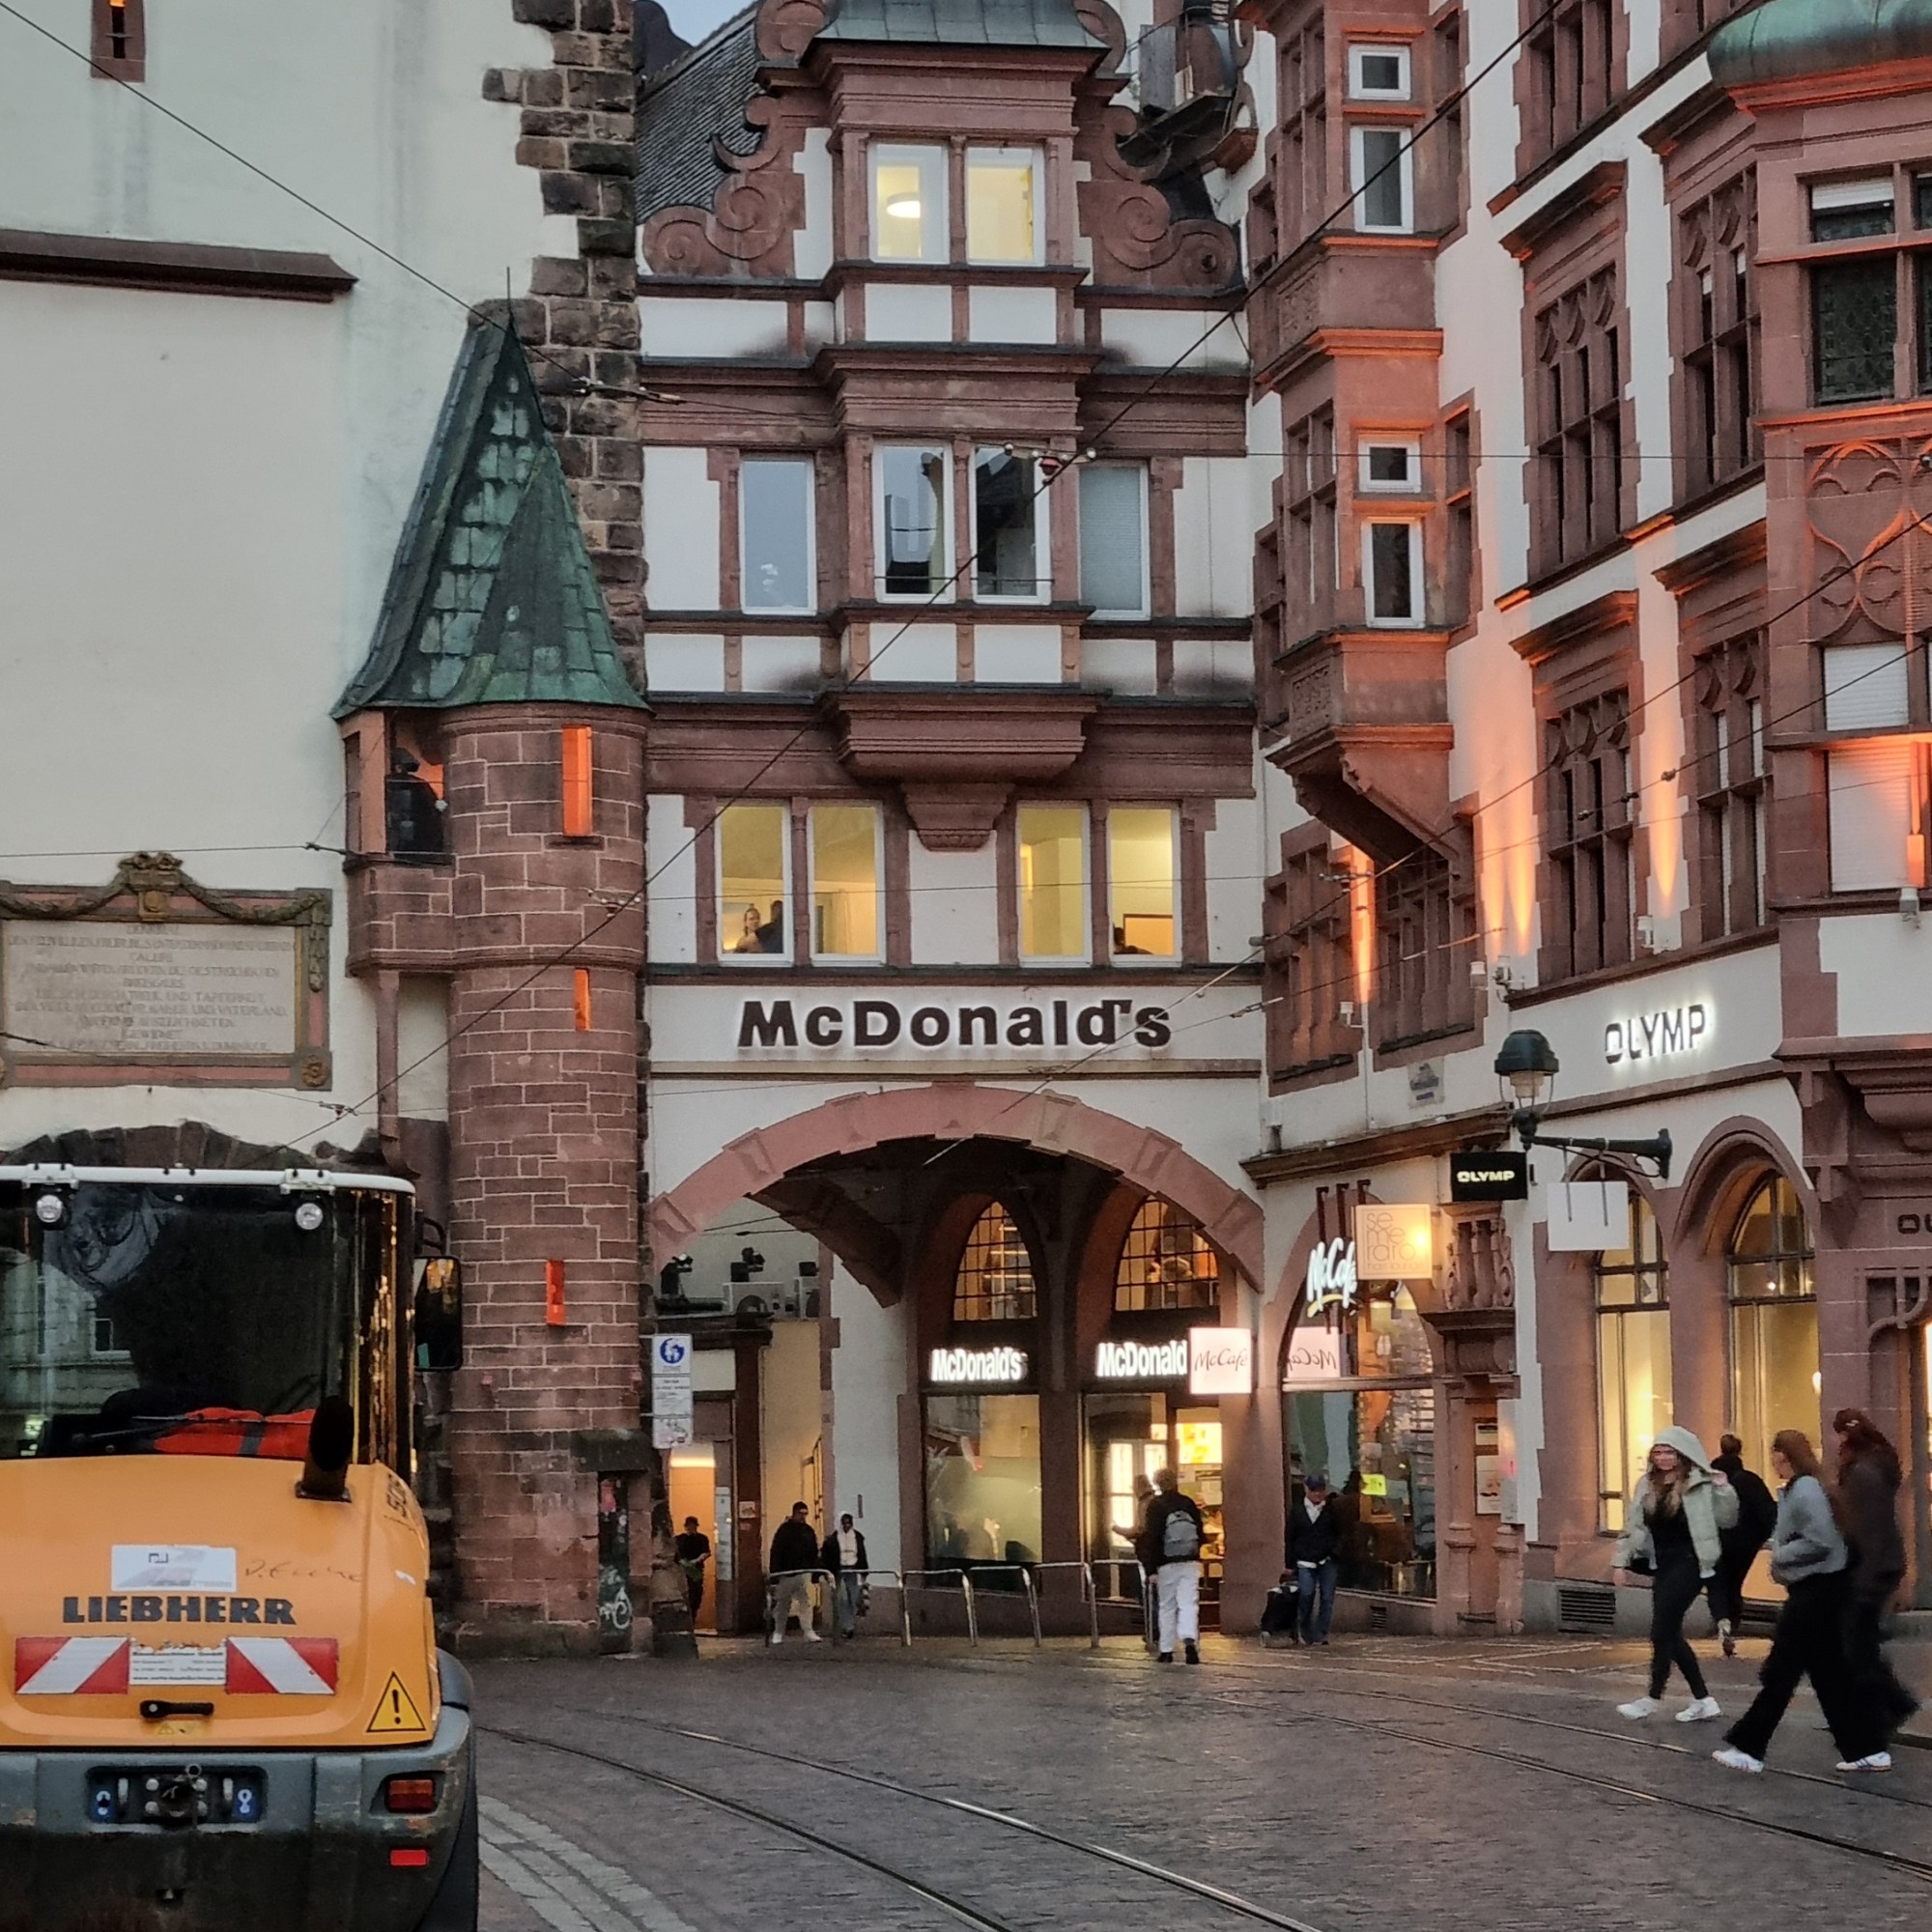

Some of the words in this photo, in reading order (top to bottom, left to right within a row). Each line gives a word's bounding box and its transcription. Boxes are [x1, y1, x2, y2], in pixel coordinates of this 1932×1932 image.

[737, 998, 1171, 1049] McDonald's
[1605, 1005, 1707, 1065] OLYMP
[1457, 1170, 1515, 1182] OLYMP
[1366, 1212, 1393, 1230] se
[931, 1348, 1025, 1381] McDonald's
[1096, 1340, 1187, 1377] McDonald
[1194, 1348, 1248, 1372] McCafé
[63, 1596, 297, 1625] LIEBHERR
